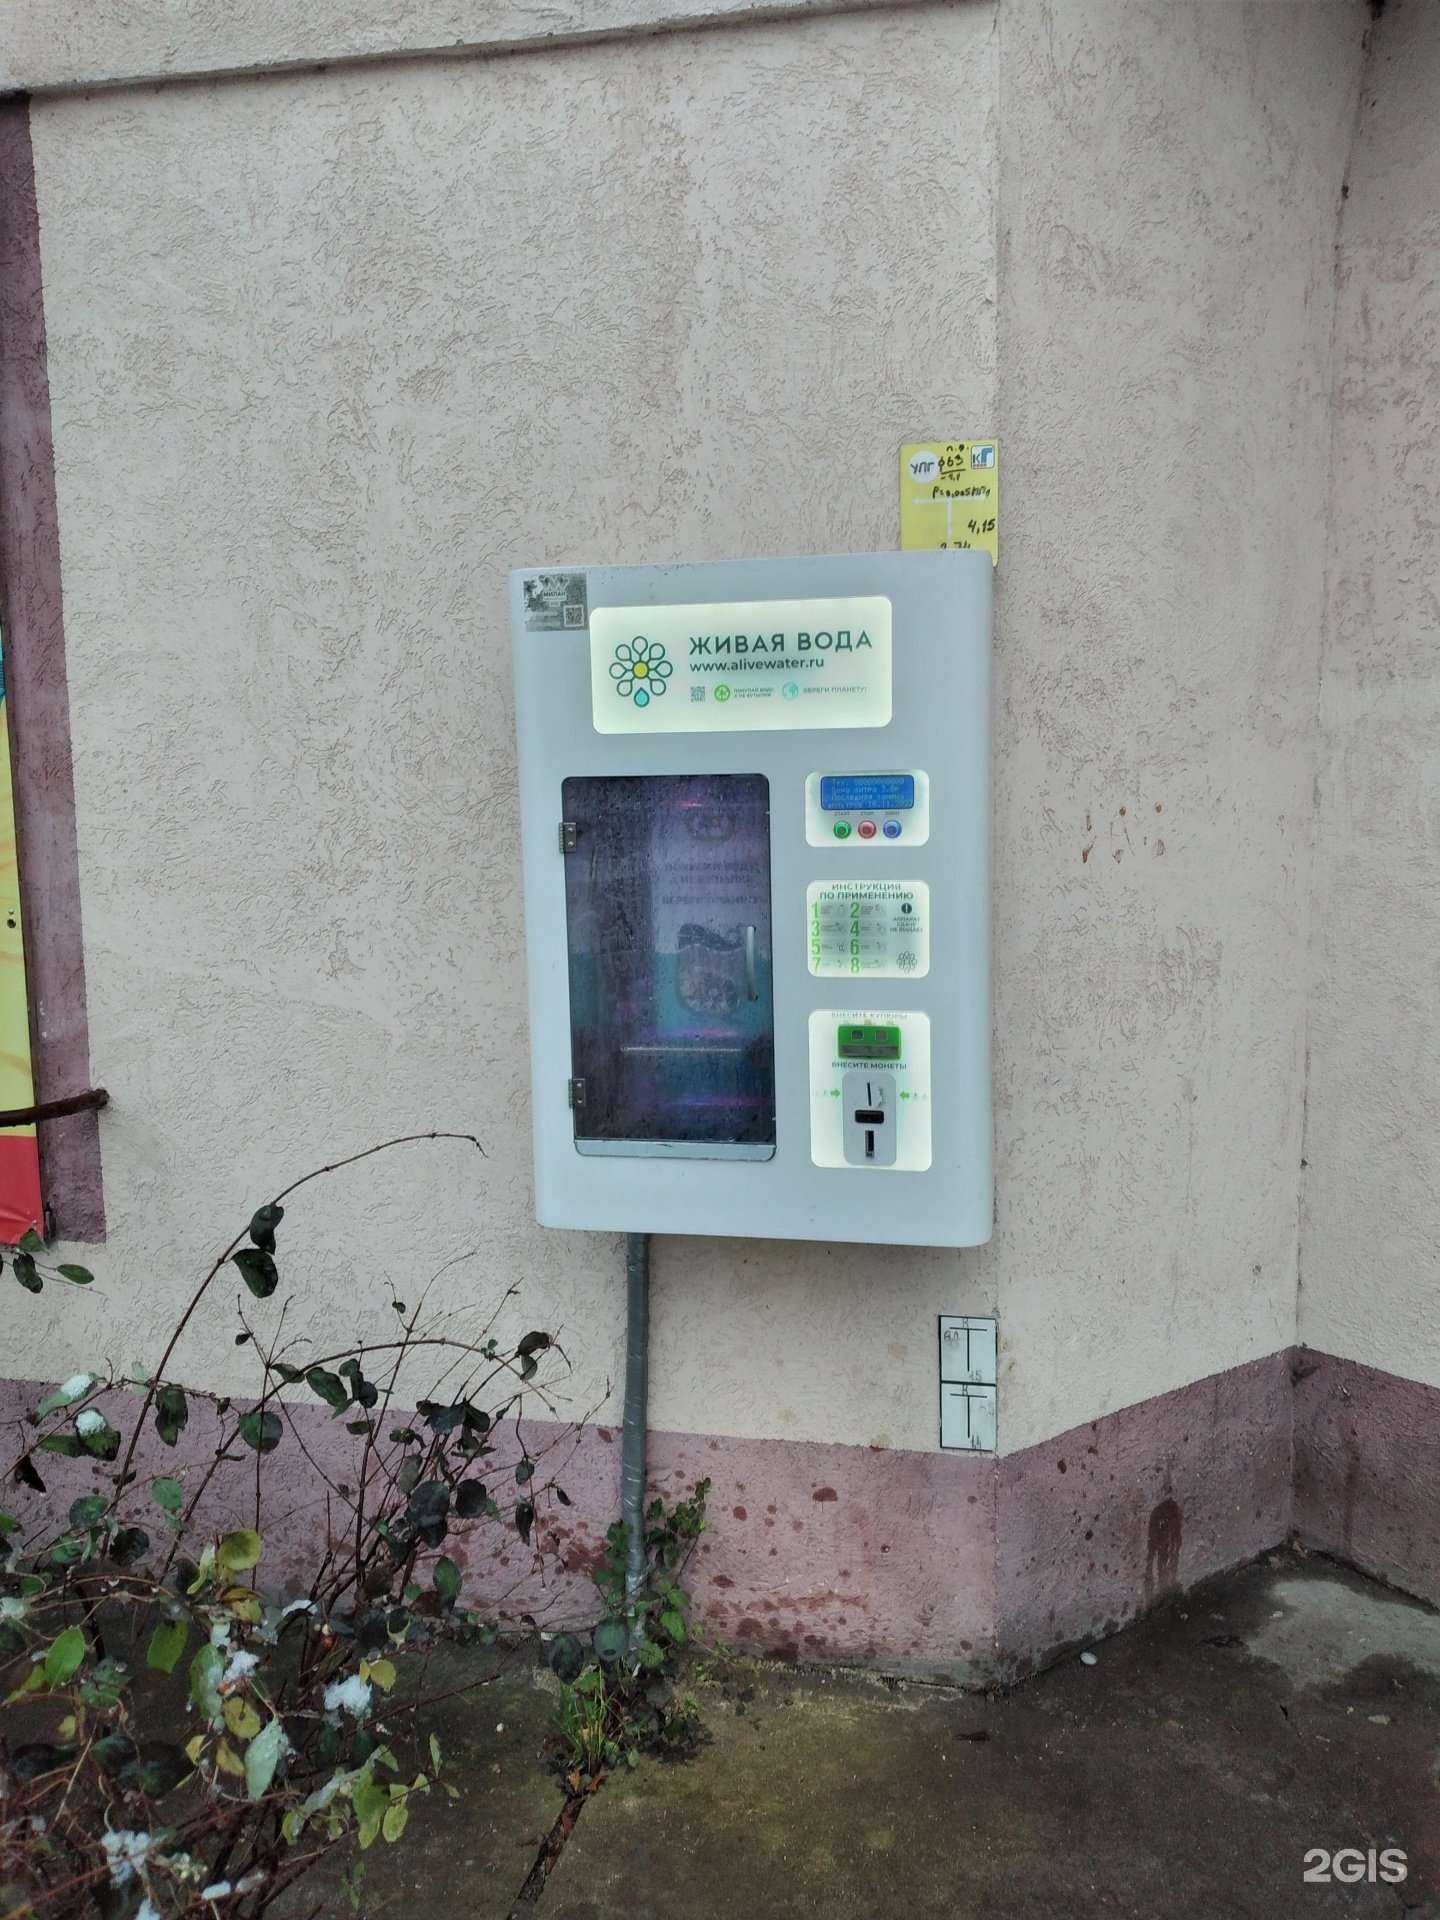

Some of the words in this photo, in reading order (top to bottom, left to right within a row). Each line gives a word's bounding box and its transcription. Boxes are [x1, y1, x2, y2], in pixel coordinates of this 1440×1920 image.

[968, 518, 996, 535] 4,15
[689, 634, 785, 656] ЖИВАЯ
[797, 630, 872, 653] ВОДА
[689, 657, 824, 673] www.alivewater.ru
[820, 892, 835, 900] ПО
[838, 891, 914, 900] ПРИМЕНЕНИЮ
[811, 901, 819, 918] 1
[850, 902, 859, 919] 2
[811, 921, 820, 937] 3
[850, 921, 860, 937] 4
[811, 939, 820, 955] 5
[850, 939, 859, 955] 6
[812, 957, 821, 972] 7
[850, 957, 860, 973] 8
[871, 1062, 907, 1070] МОНЕТЫ
